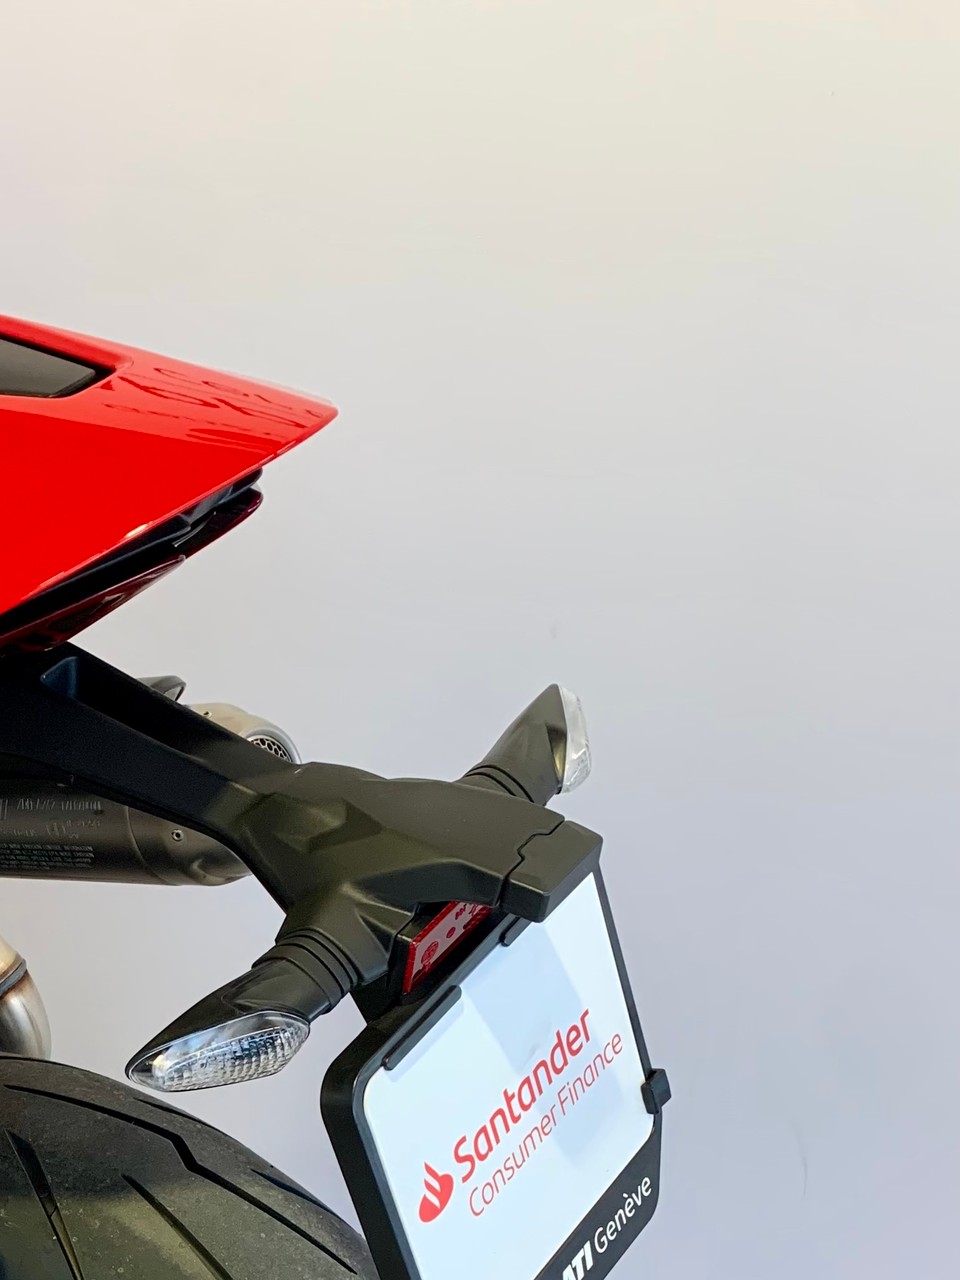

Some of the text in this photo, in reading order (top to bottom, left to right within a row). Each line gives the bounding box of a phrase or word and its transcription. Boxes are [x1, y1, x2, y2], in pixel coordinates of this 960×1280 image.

[453, 1008, 590, 1184] Santander
[469, 1033, 623, 1216] Consumer Finance
[594, 1176, 652, 1254] Genève
